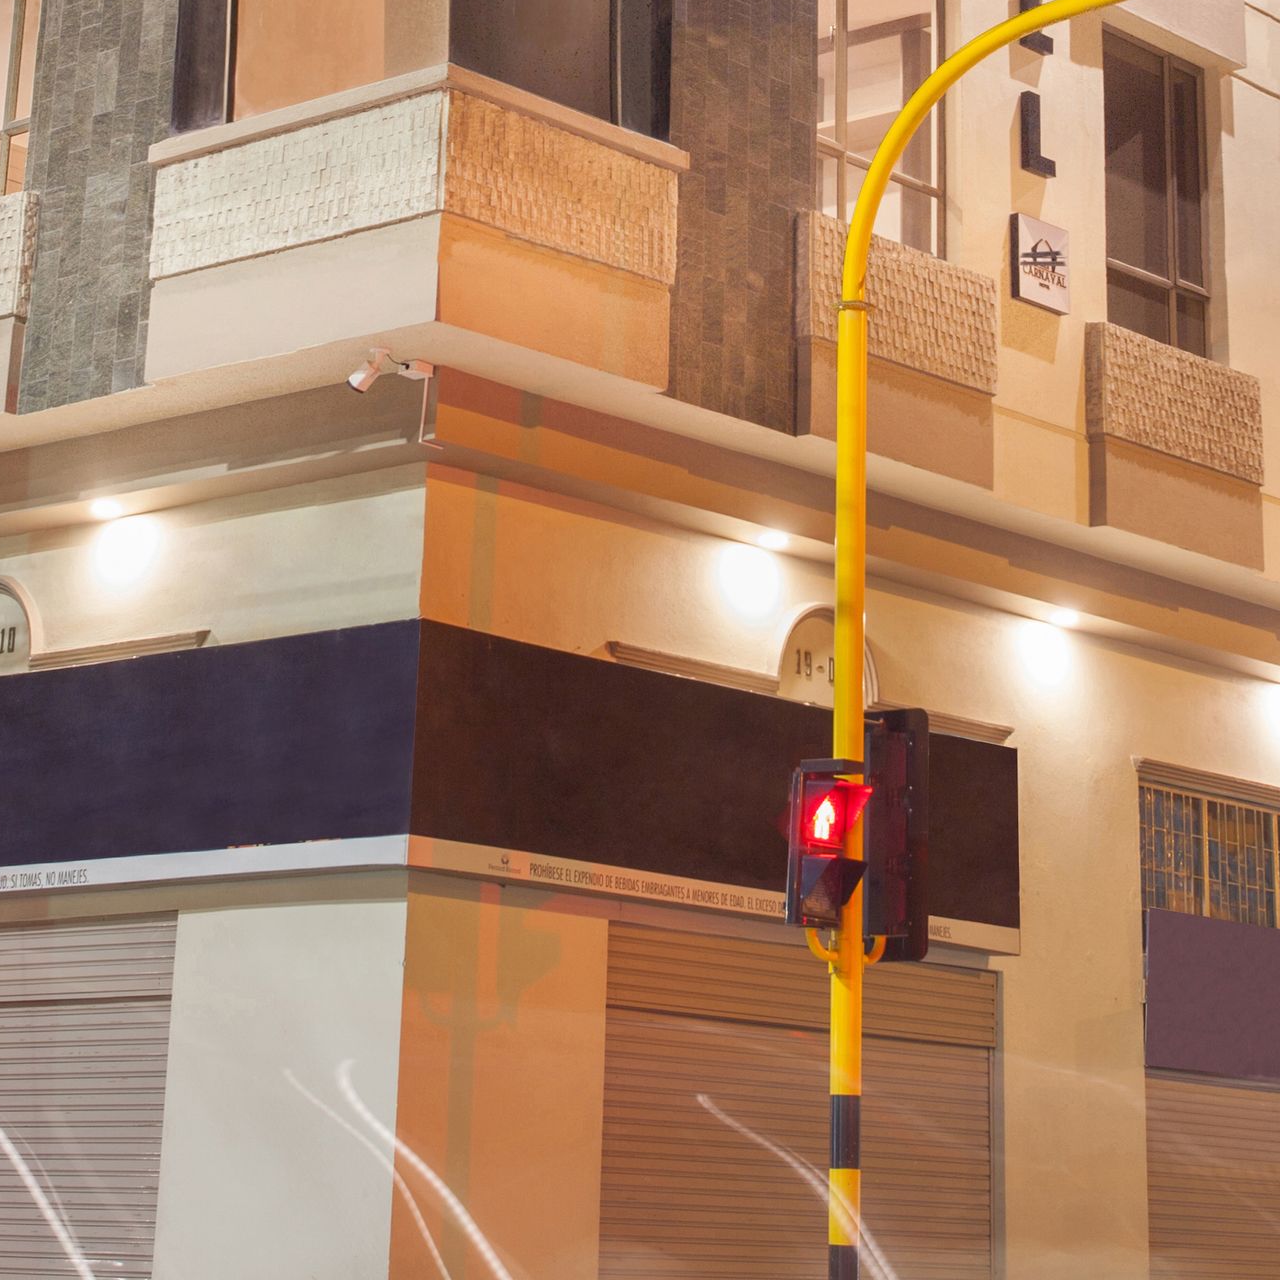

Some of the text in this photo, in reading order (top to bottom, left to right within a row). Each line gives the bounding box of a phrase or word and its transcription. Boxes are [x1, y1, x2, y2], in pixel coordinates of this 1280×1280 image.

[795, 648, 835, 683] 19-0
[10, 873, 18, 889] SI
[19, 871, 44, 889] TOMAS,
[46, 870, 56, 886] NO
[57, 868, 90, 885] MANEJES.
[530, 861, 564, 882] PROHÍBESE
[565, 864, 573, 883] EL
[574, 866, 604, 888] EXPENDIO
[605, 871, 613, 889] DE
[615, 872, 640, 892] BEBIDAS
[641, 876, 685, 900] EMBRIAGANTES
[686, 884, 691, 899] A
[692, 883, 720, 905] MENORES
[721, 889, 729, 906] DE
[747, 893, 755, 909] EL
[755, 894, 777, 914] EXCESO
